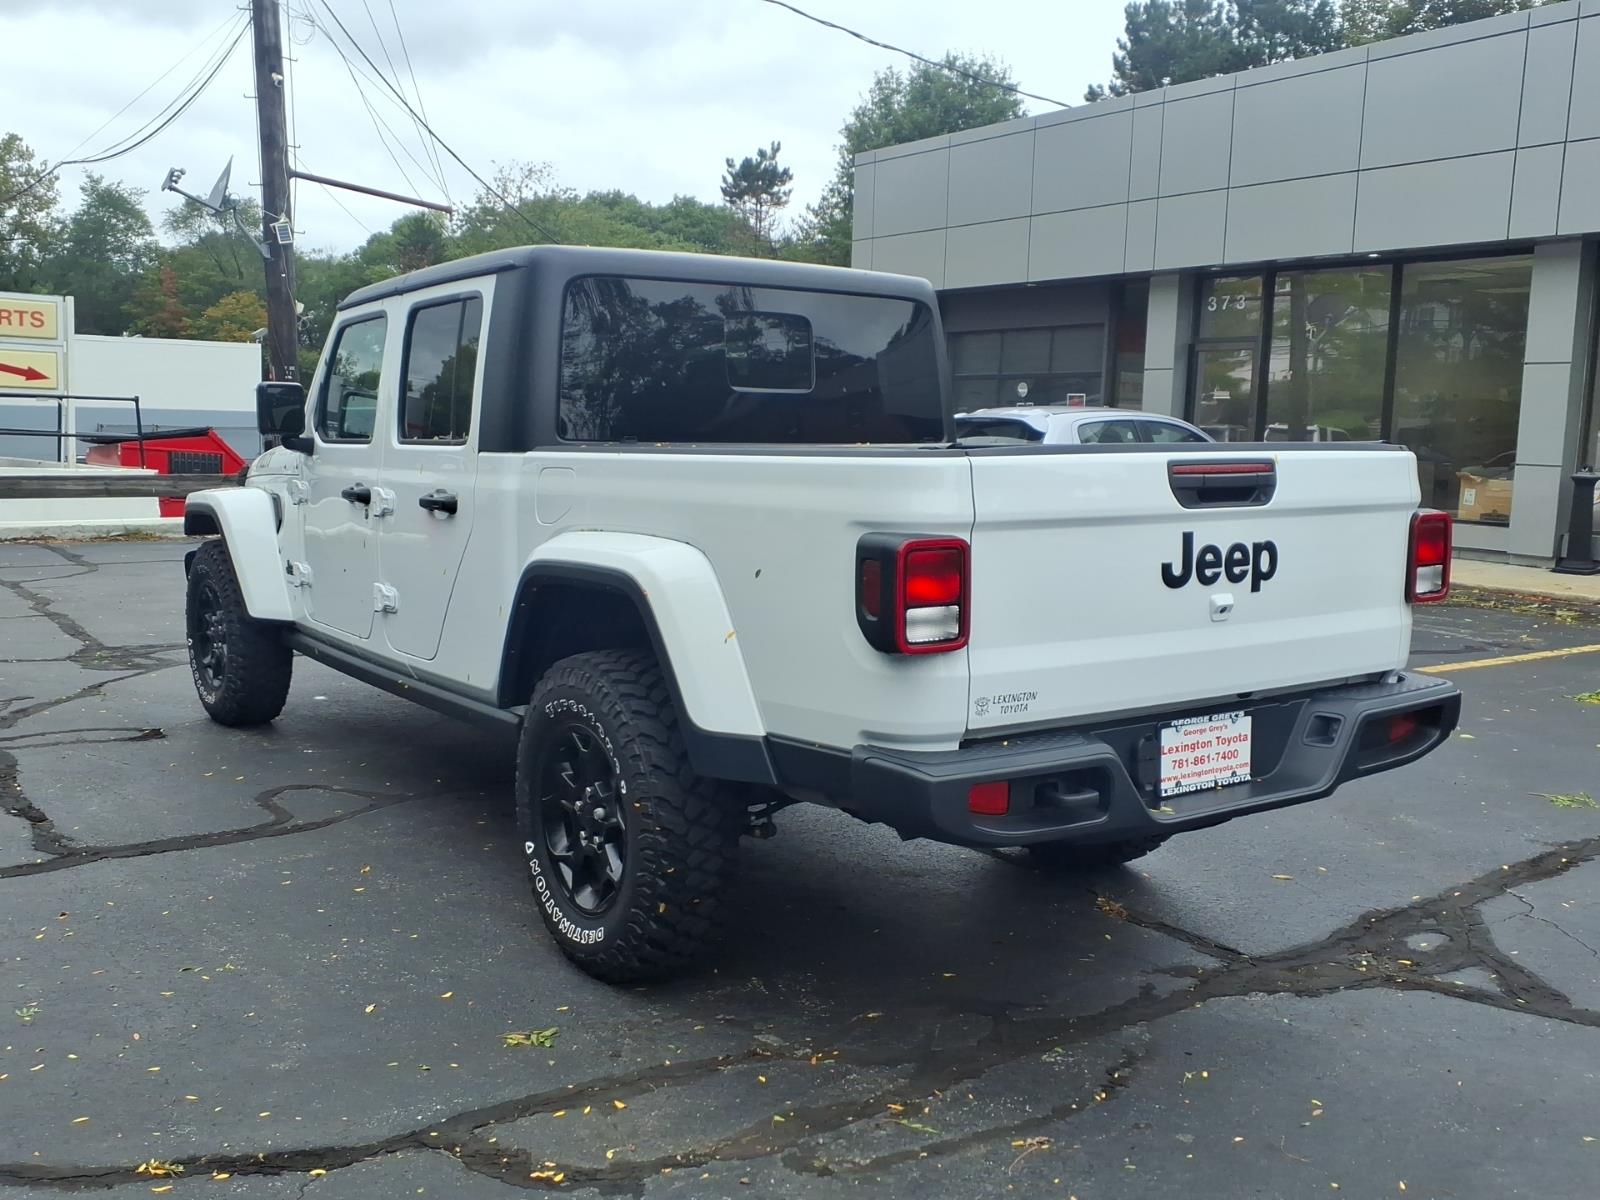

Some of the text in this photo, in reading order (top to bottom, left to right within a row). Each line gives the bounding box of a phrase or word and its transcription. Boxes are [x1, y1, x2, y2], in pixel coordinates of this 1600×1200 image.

[1207, 294, 1246, 311] 373
[1161, 531, 1278, 593] Jeep
[992, 691, 1038, 705] LEXINGTON
[1000, 703, 1028, 714] TOYOTA
[1171, 715, 1210, 727] GEORGE
[1183, 723, 1228, 737] George Grey's
[1161, 732, 1249, 756] Lexington Toyota
[1171, 748, 1240, 770] 781-861-7400
[1161, 761, 1250, 783] www.lexingtontoyota.com
[1161, 774, 1252, 797] LEXINGTON TOYOTA
[529, 858, 605, 944] DESTINATION
